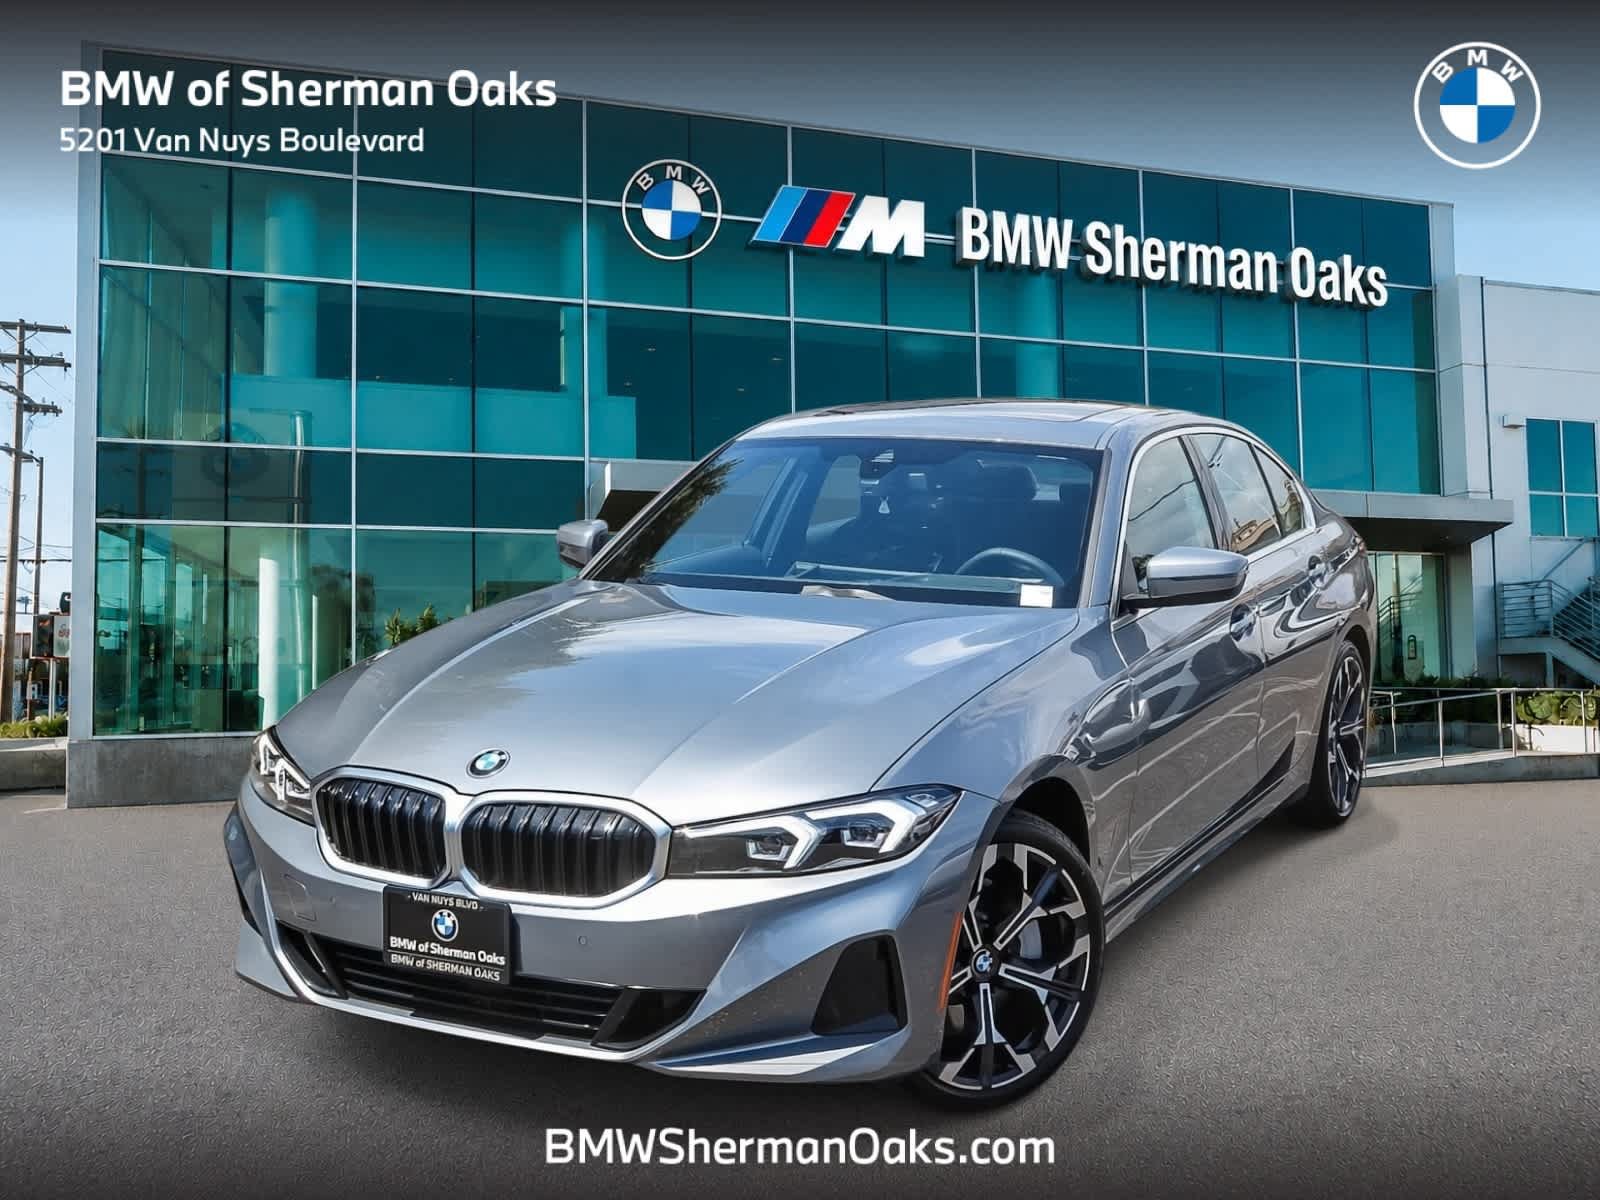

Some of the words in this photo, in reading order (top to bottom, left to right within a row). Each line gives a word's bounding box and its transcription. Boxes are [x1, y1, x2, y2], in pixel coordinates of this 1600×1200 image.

[961, 206, 1073, 270] BMW
[1084, 220, 1278, 294] Sherman
[1290, 246, 1388, 308] Oaks
[411, 892, 430, 903] VAN
[431, 894, 454, 907] NUYS
[456, 899, 478, 910] BLVD
[390, 936, 416, 951] BMW
[418, 942, 429, 953] of
[430, 942, 476, 961] Sherman
[478, 950, 506, 966] Oaks
[391, 953, 415, 967] BMW
[415, 957, 425, 968] of
[426, 959, 472, 977] SHERMAN
[474, 967, 500, 981] OAKS
